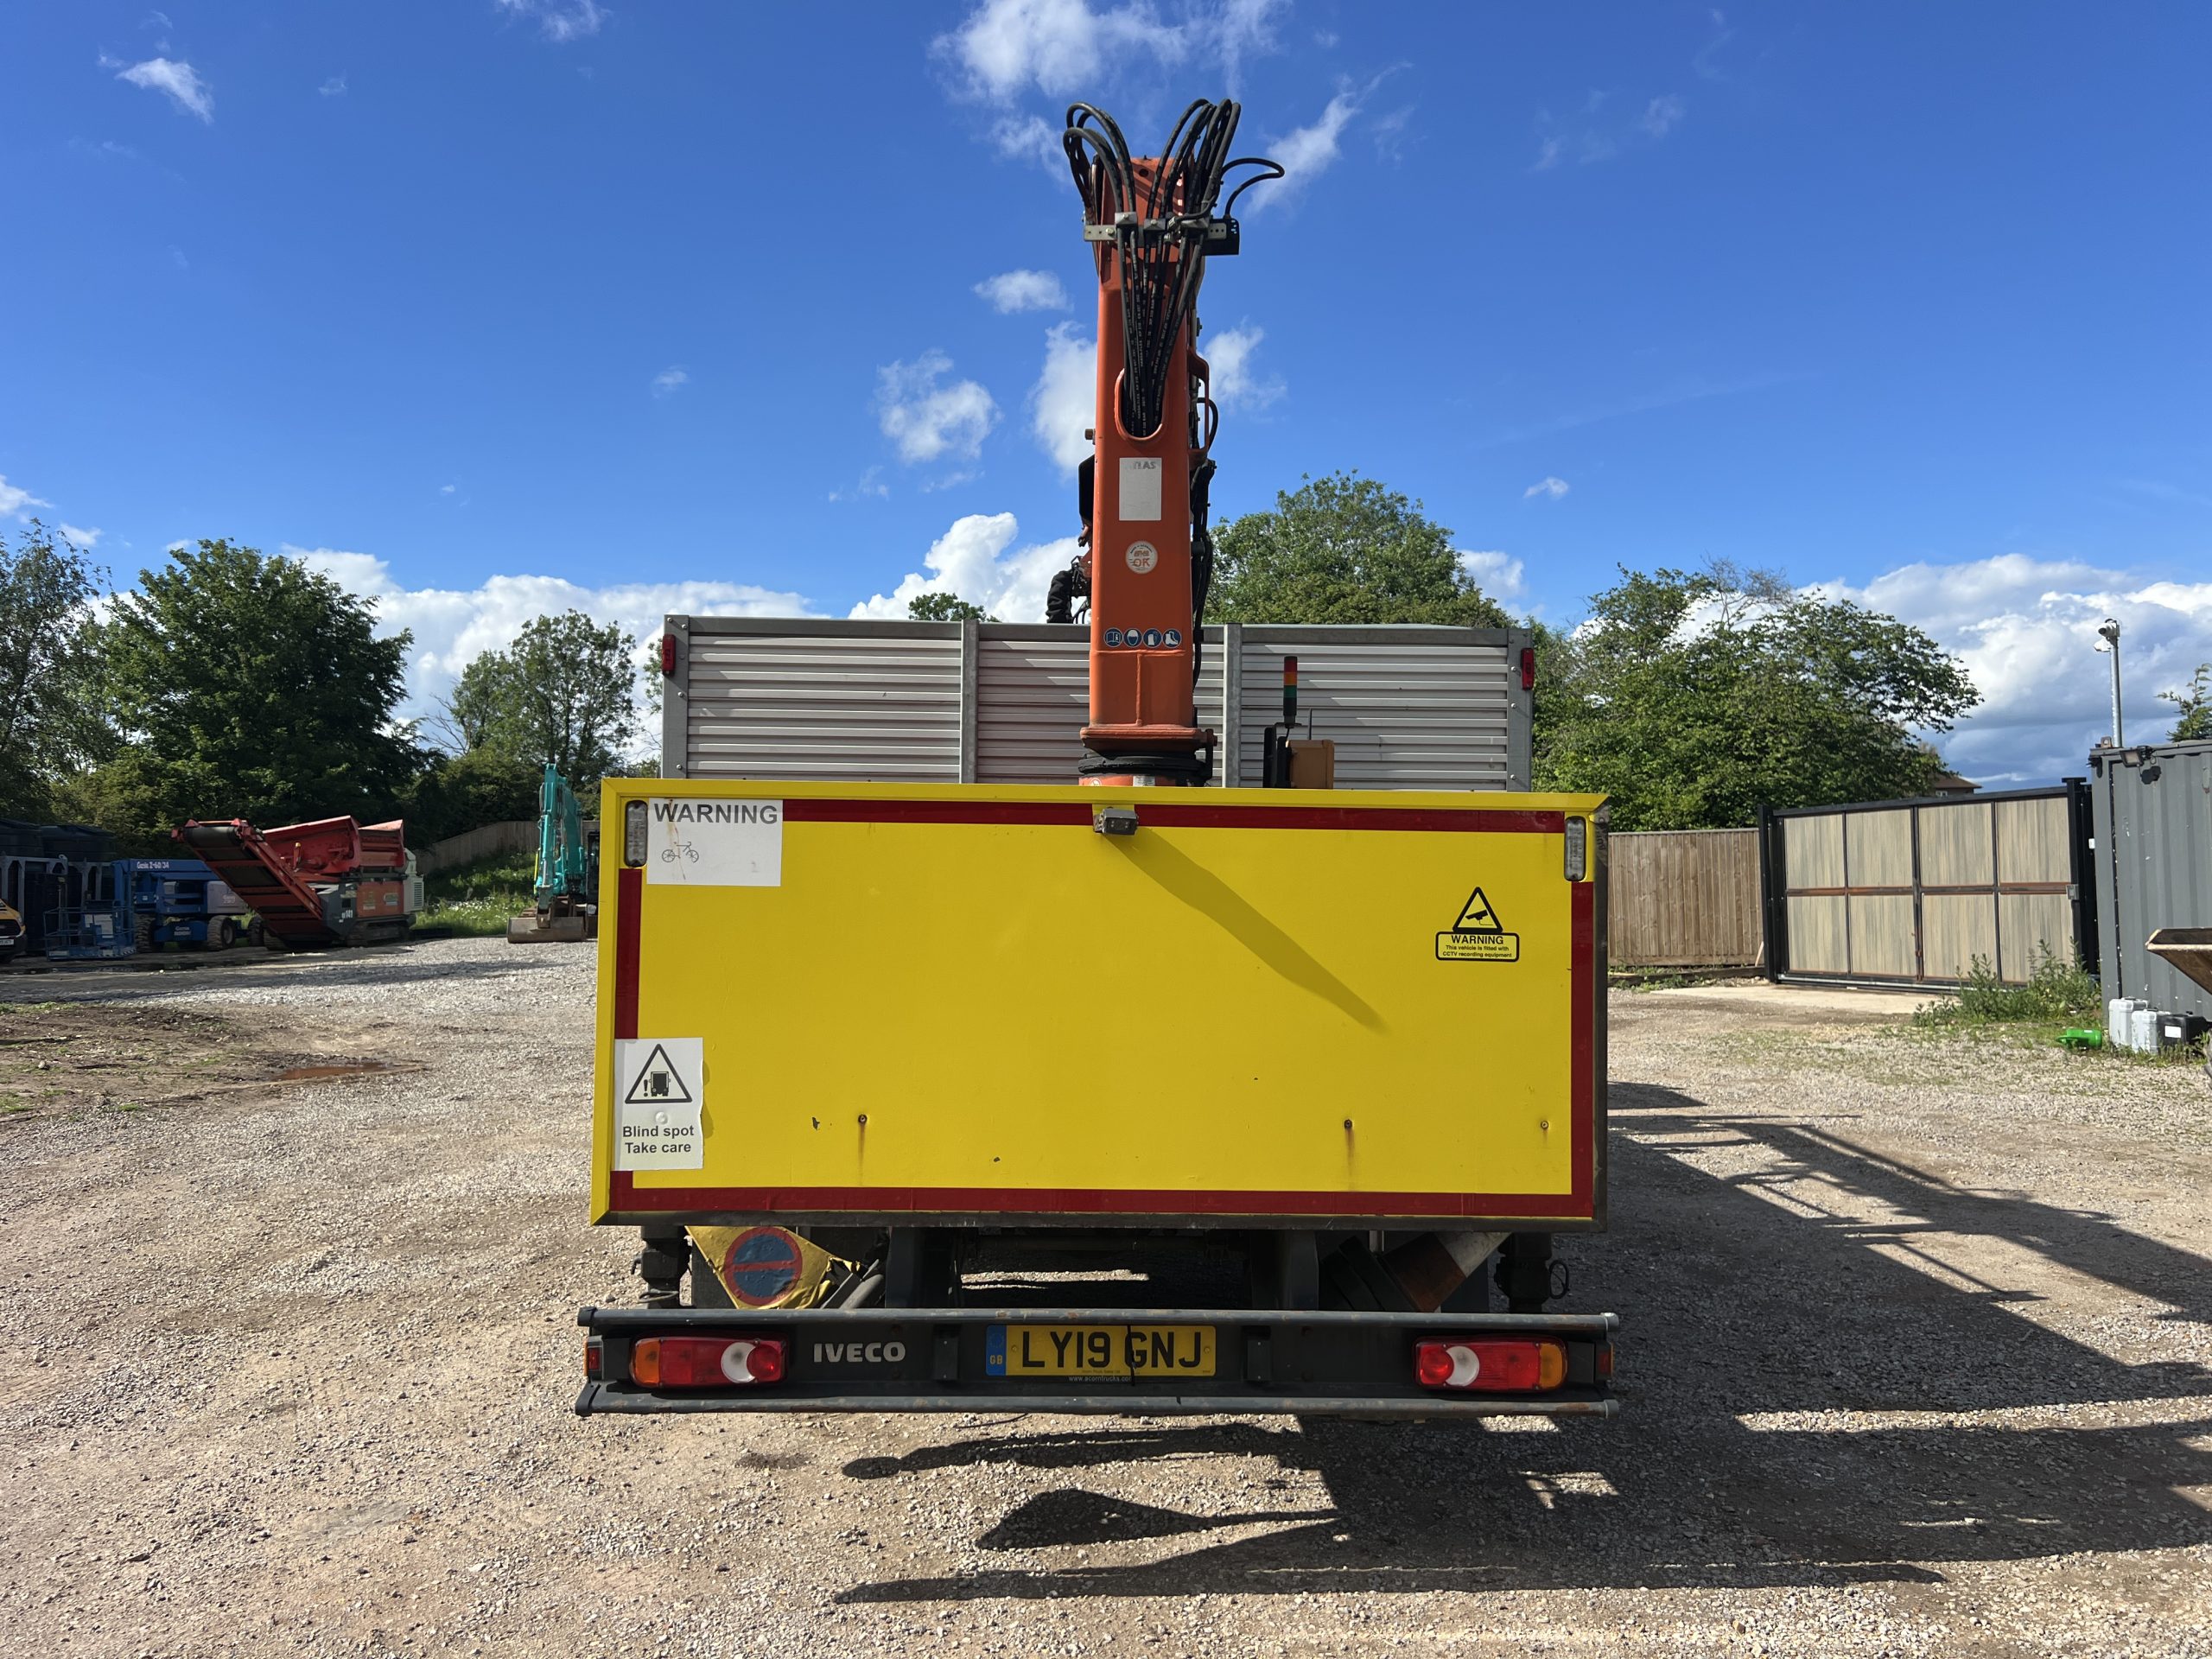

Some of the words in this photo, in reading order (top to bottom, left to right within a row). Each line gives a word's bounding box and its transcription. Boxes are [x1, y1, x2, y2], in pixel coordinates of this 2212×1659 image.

[654, 803, 779, 824] WARNING
[1452, 935, 1503, 944] WARNING
[622, 1125, 659, 1138] Blind
[663, 1124, 695, 1140] spot
[625, 1141, 658, 1154] Take
[661, 1142, 691, 1154] care
[813, 1341, 906, 1363] IVECO
[1022, 1331, 1111, 1369] LY19
[1124, 1331, 1202, 1369] GNJ
[989, 1354, 1003, 1365] GB
